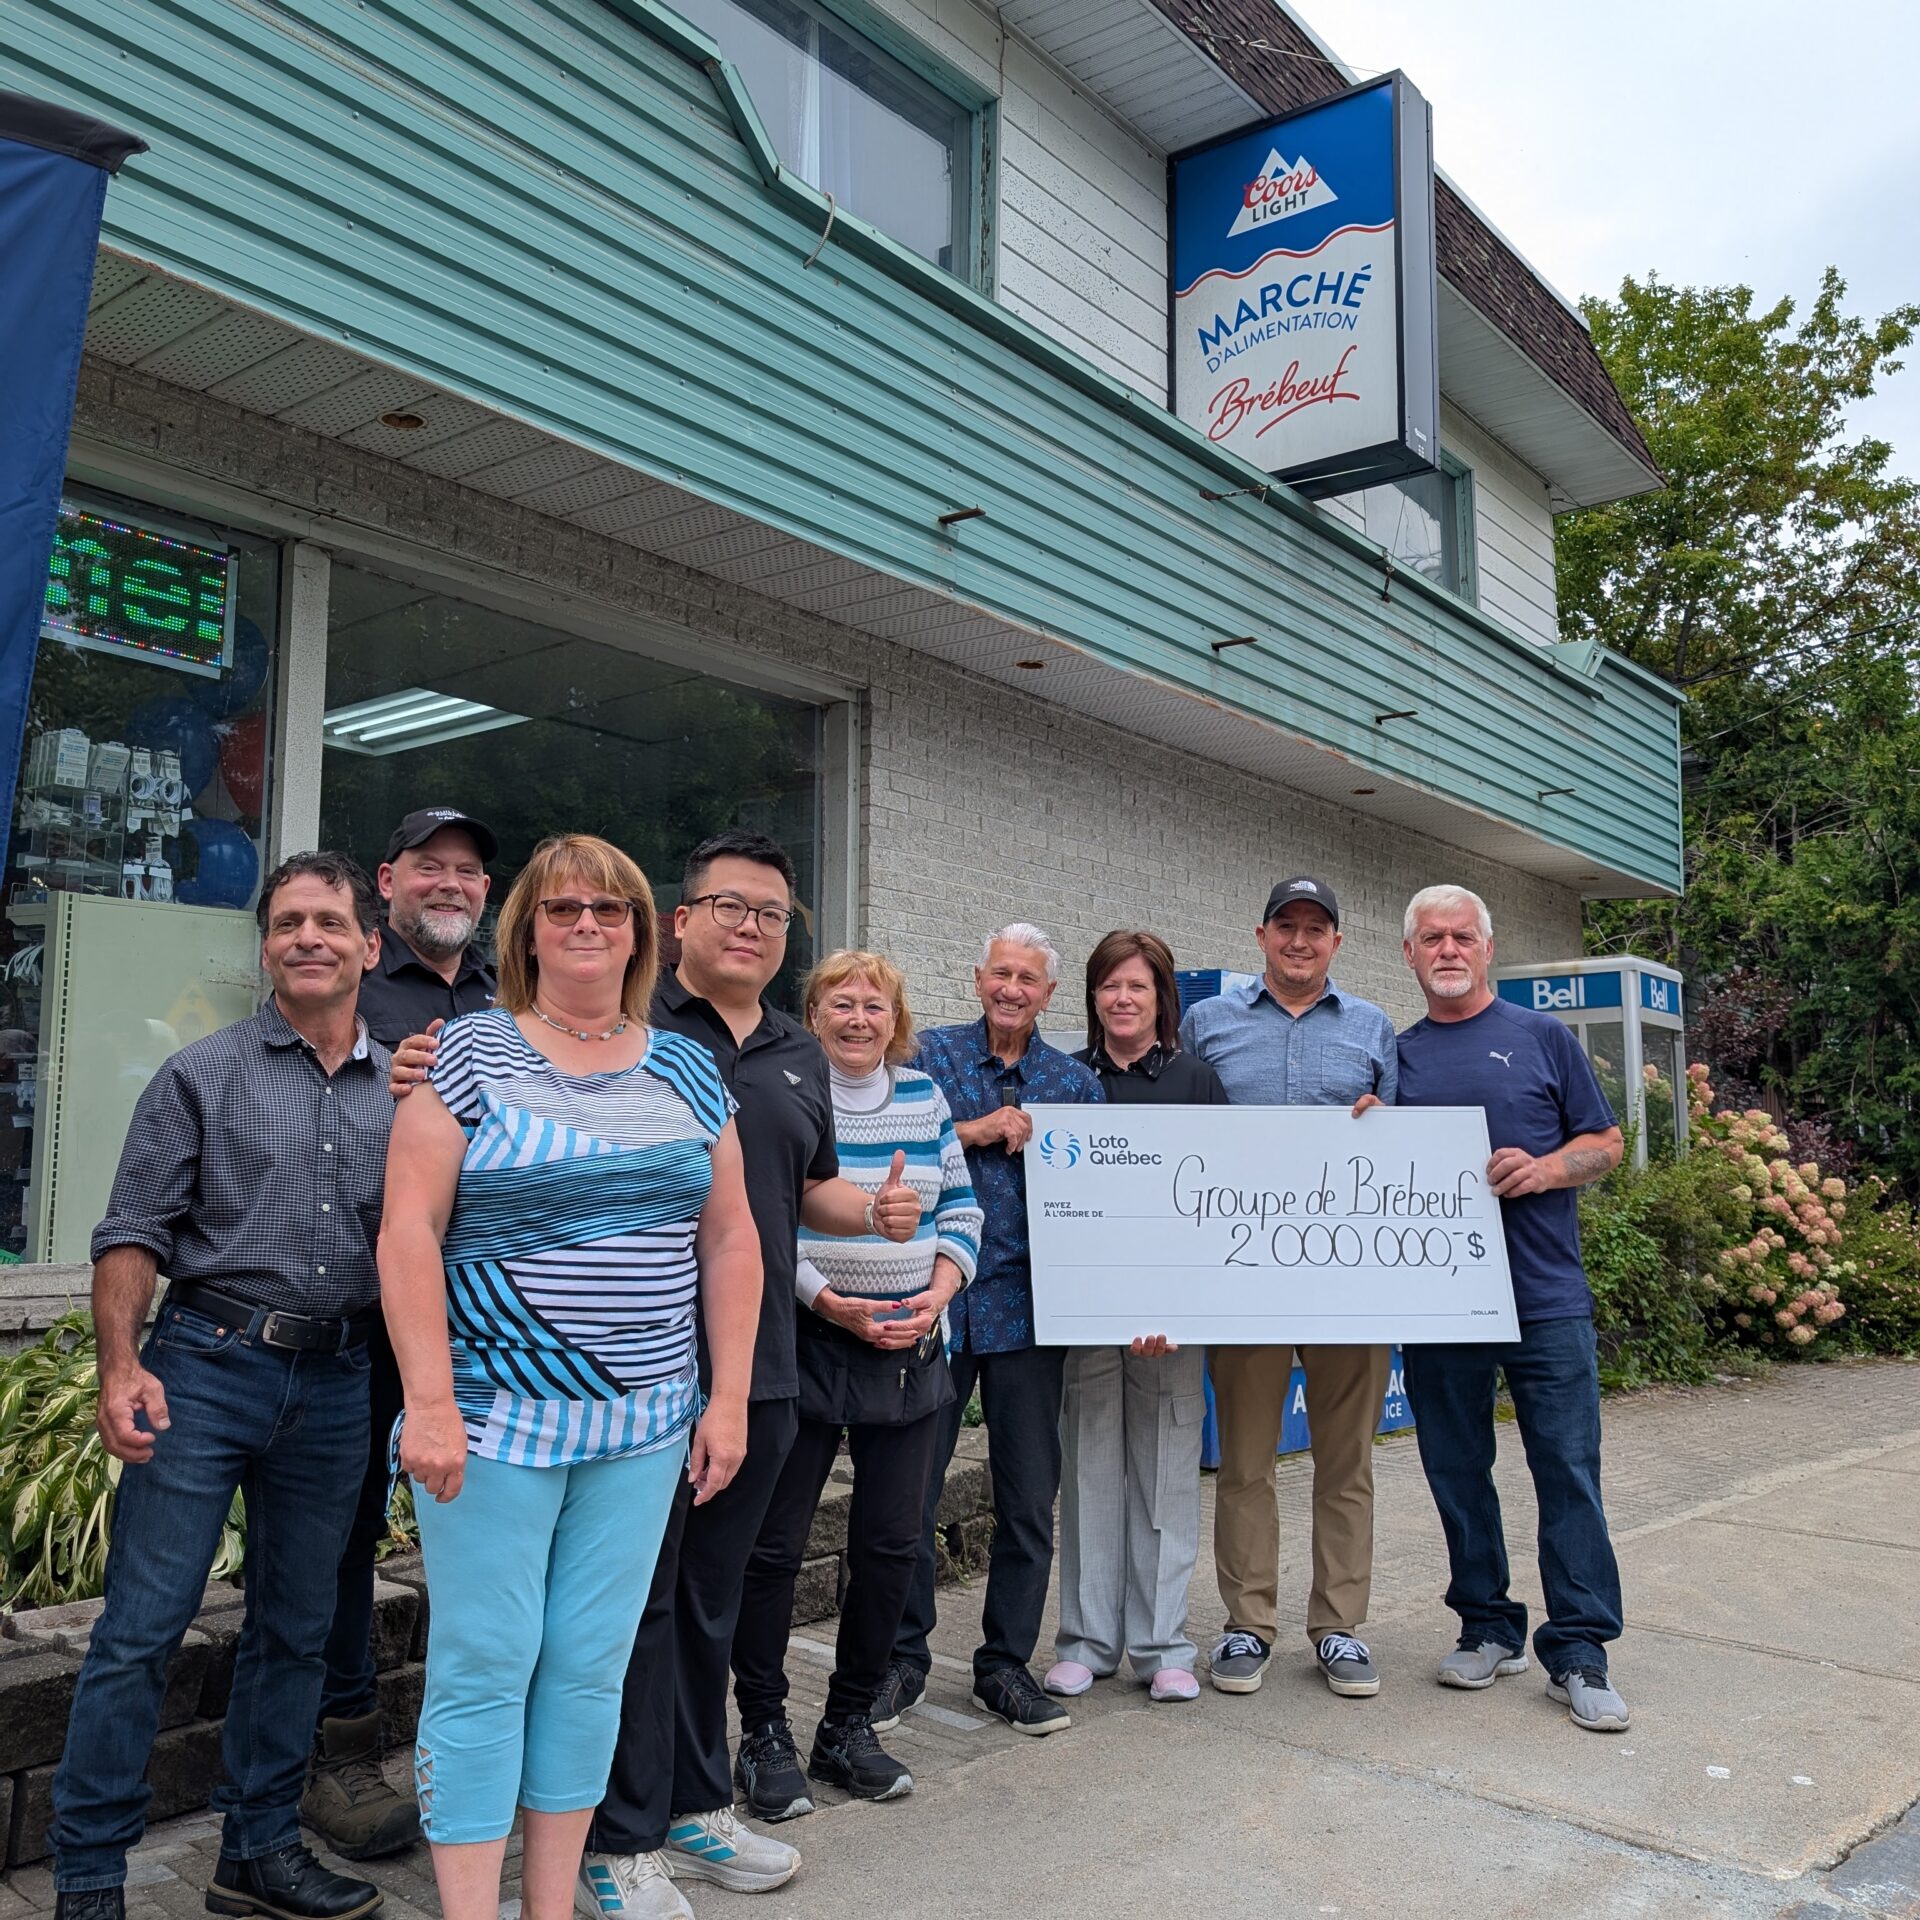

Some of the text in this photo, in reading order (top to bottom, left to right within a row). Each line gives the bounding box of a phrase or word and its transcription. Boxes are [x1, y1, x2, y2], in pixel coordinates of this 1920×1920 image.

[1243, 165, 1319, 209] Coors
[1252, 189, 1309, 223] LIGHT
[1197, 264, 1372, 356] MARCHÉ
[1206, 311, 1358, 374] D'ALIMENTATION
[1208, 344, 1359, 442] Brébeuf
[1532, 976, 1585, 1010] Bell
[1650, 977, 1669, 1011] Bell
[1089, 1134, 1129, 1149] Loto
[1089, 1150, 1163, 1166] Québec
[1043, 1201, 1072, 1209] PAYEZ
[1173, 1154, 1479, 1231] Groupe de Brébeuf
[1044, 1209, 1104, 1218] À L'ORDRE DE
[1225, 1223, 1260, 1266] 2
[1271, 1223, 1363, 1267] 000
[1385, 1402, 1403, 1419] ICE
